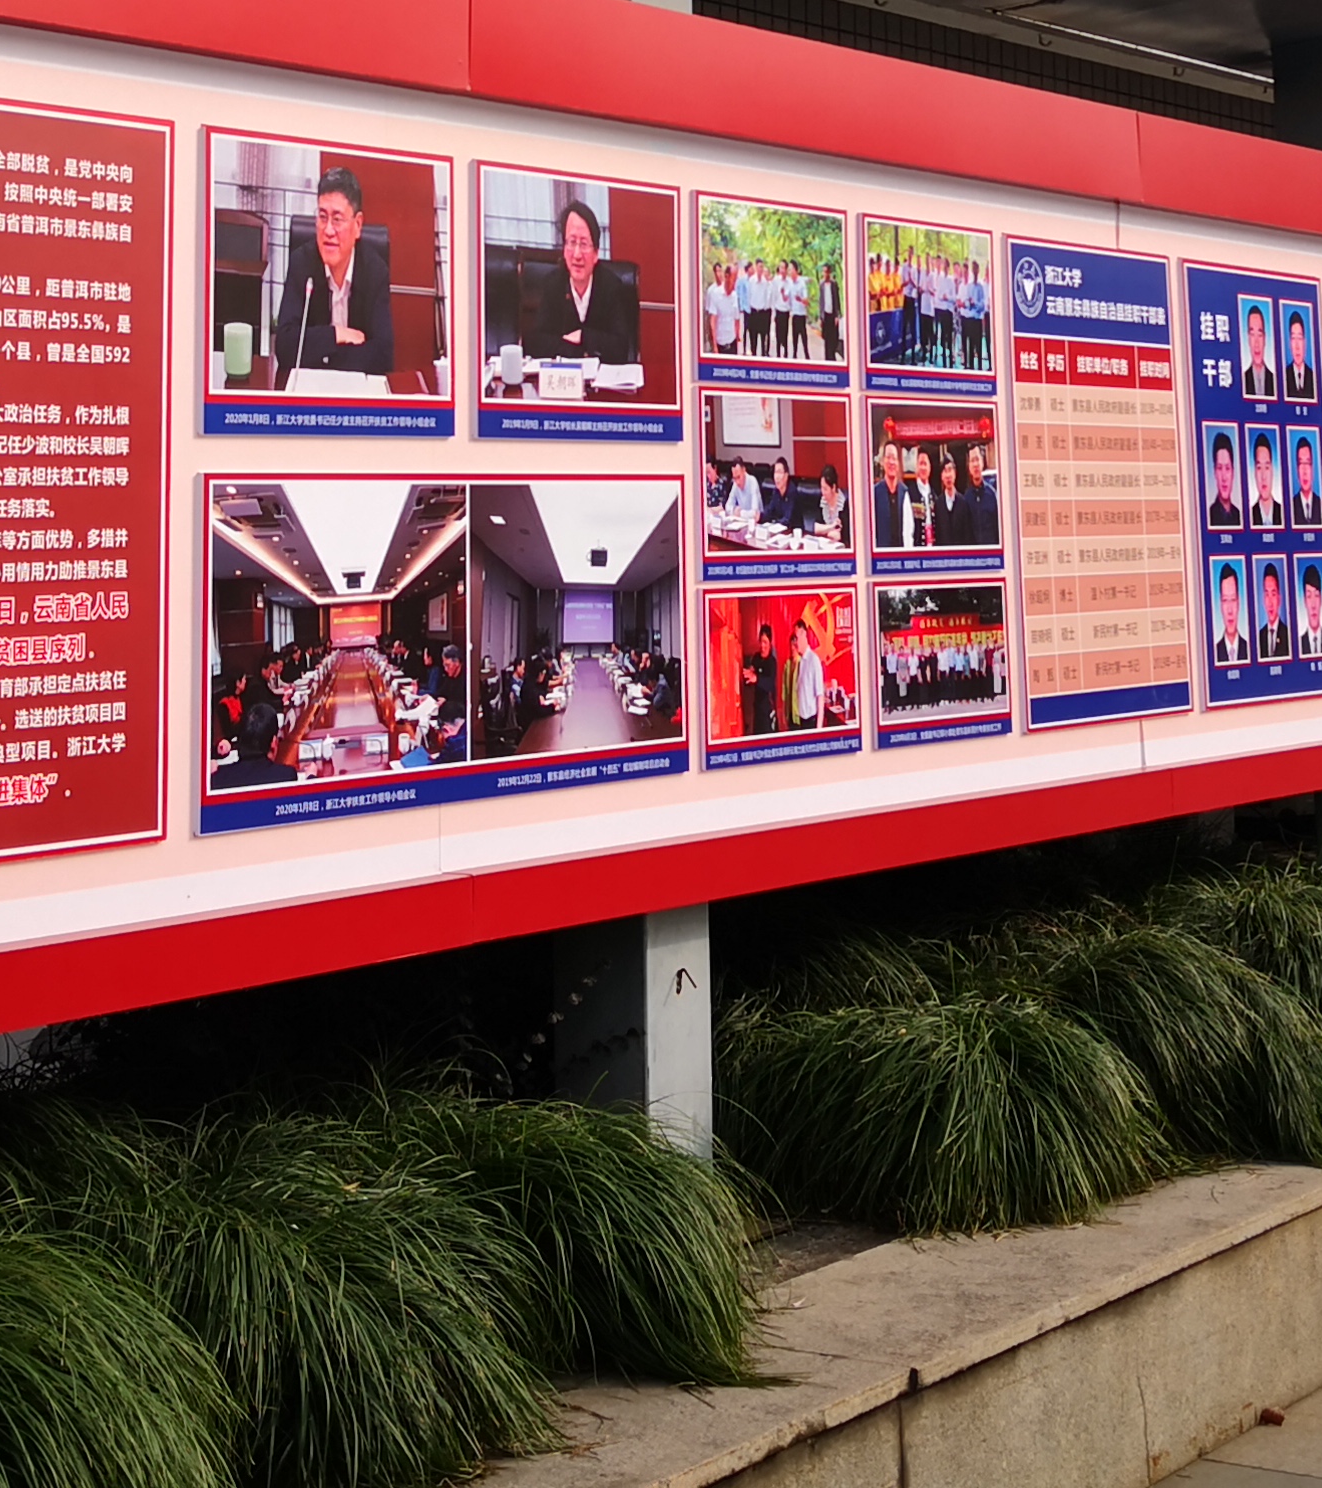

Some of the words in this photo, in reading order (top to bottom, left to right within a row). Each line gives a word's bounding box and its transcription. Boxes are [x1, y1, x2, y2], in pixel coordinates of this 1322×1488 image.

[1044, 264, 1083, 288] 浙江大学
[1200, 311, 1230, 342] 挂职
[1019, 351, 1039, 371] 姓名
[1202, 358, 1233, 388] 干部
